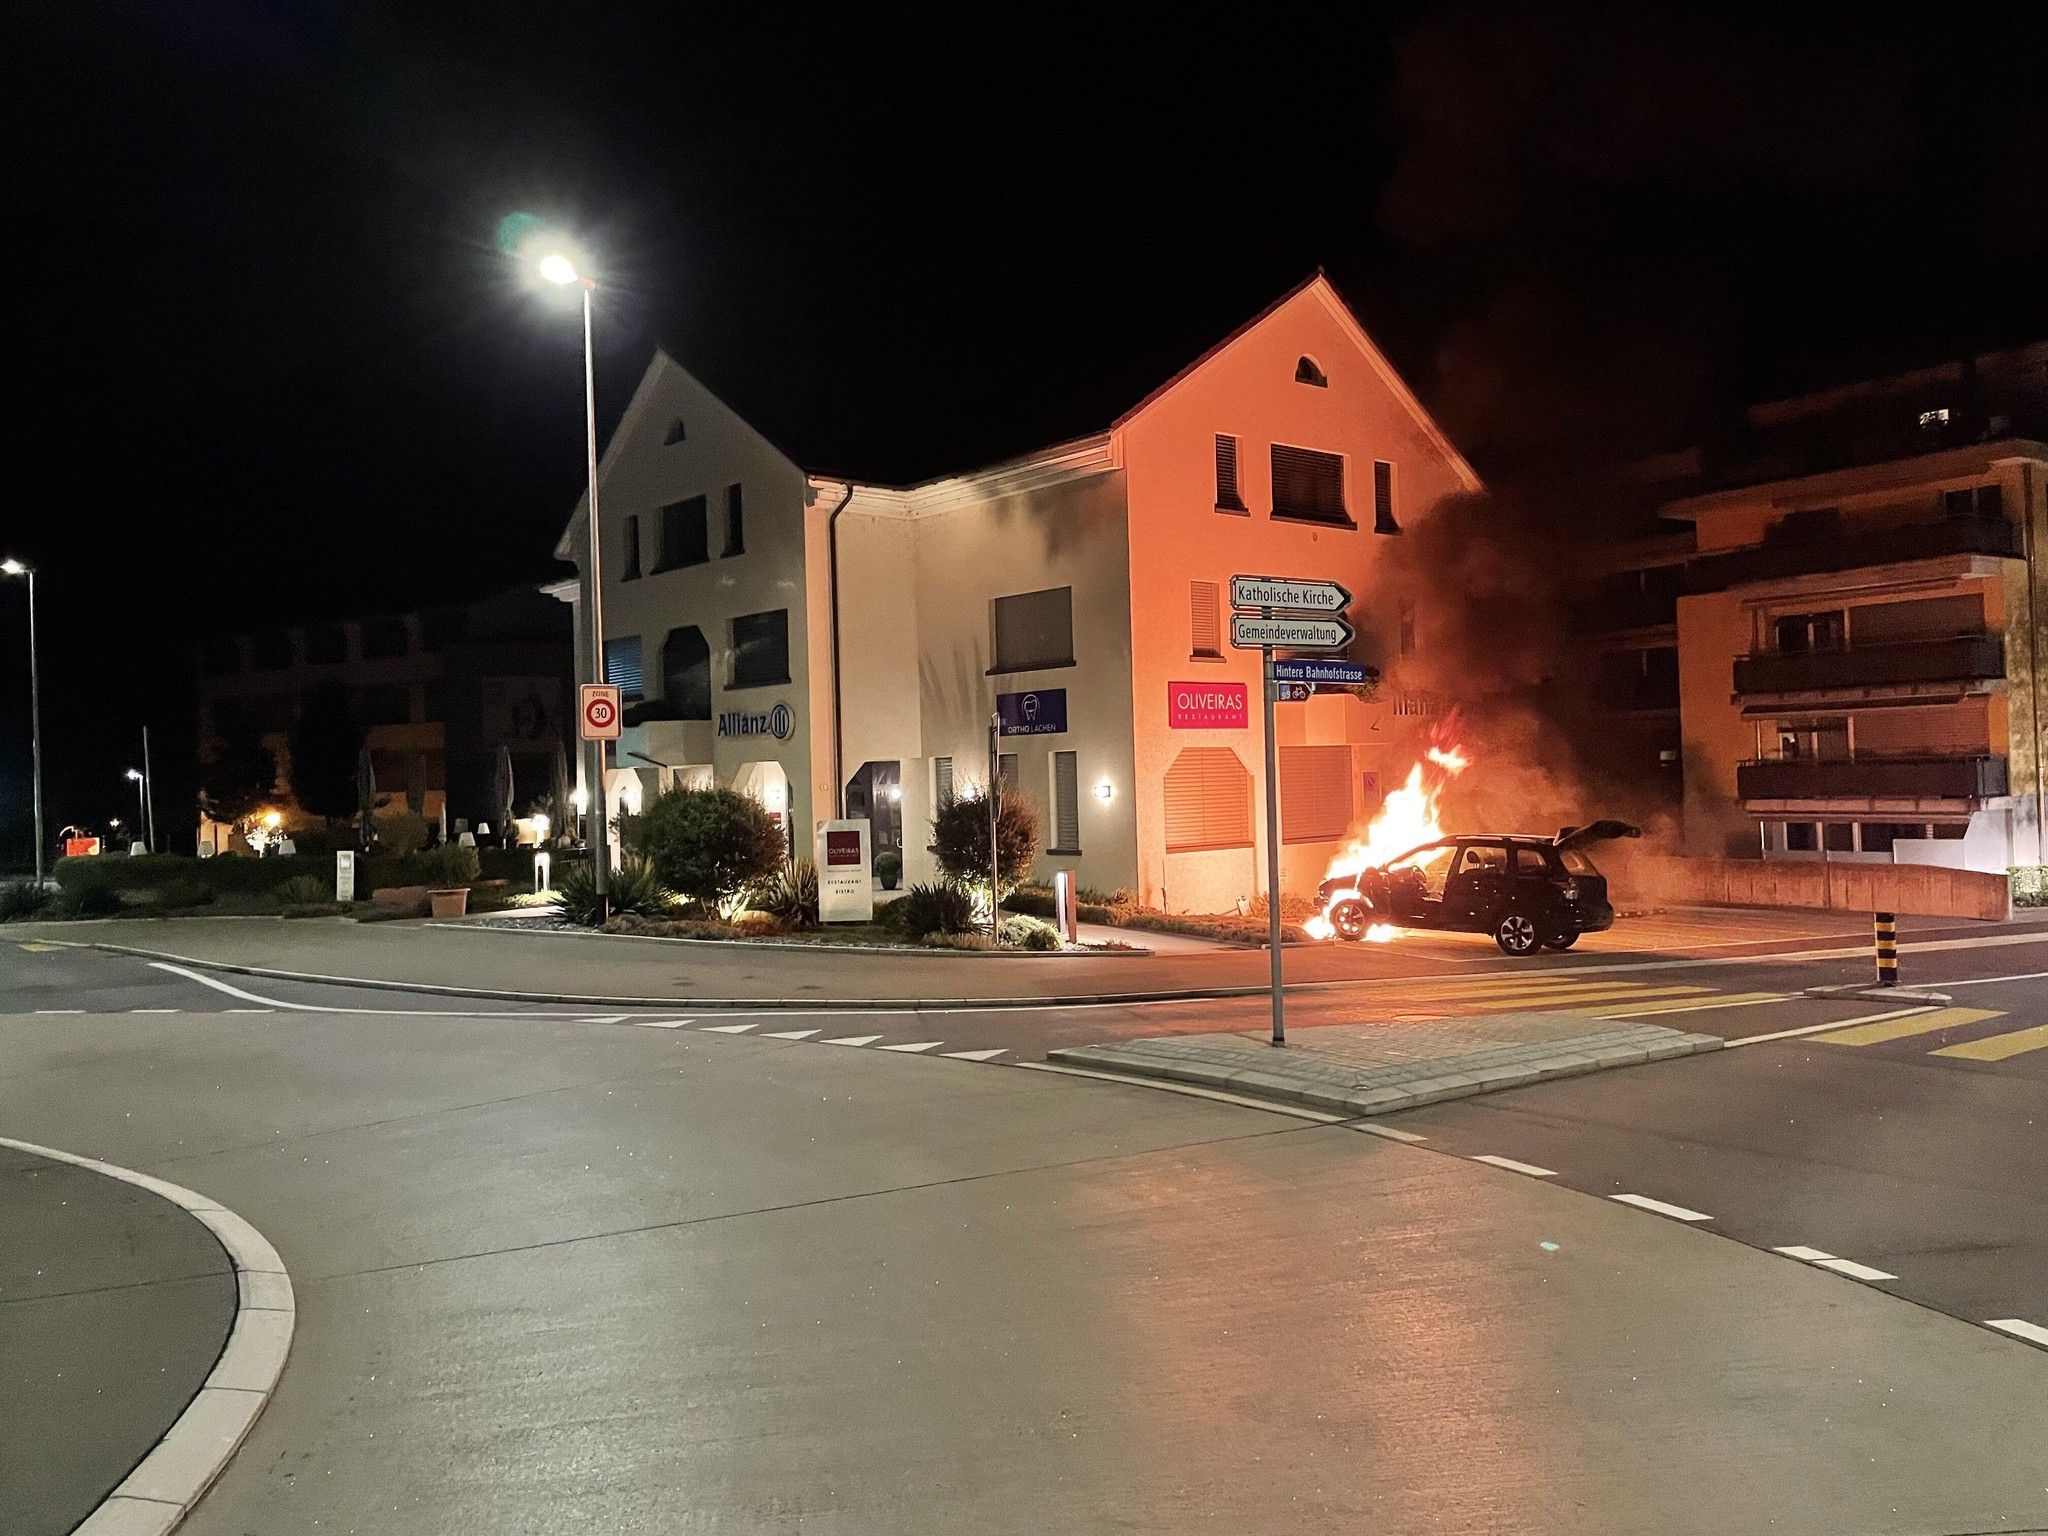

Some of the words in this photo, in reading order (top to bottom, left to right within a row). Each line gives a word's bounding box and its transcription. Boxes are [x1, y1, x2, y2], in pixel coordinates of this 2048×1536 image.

[1238, 585, 1300, 603] Katholische
[1302, 589, 1334, 606] Kirche
[1238, 624, 1337, 644] Gemeindeverwaltung
[1276, 664, 1304, 678] Hintere
[1306, 665, 1363, 680] Bahnhofstrasse
[592, 690, 610, 698] ZONE
[1177, 692, 1243, 710] OLIVEIRAS
[594, 707, 607, 719] 30
[718, 711, 768, 737] Allianz
[1008, 725, 1030, 734] ORTHO
[1031, 723, 1056, 733] LACHEN
[828, 847, 860, 855] OLIVEIRAS
